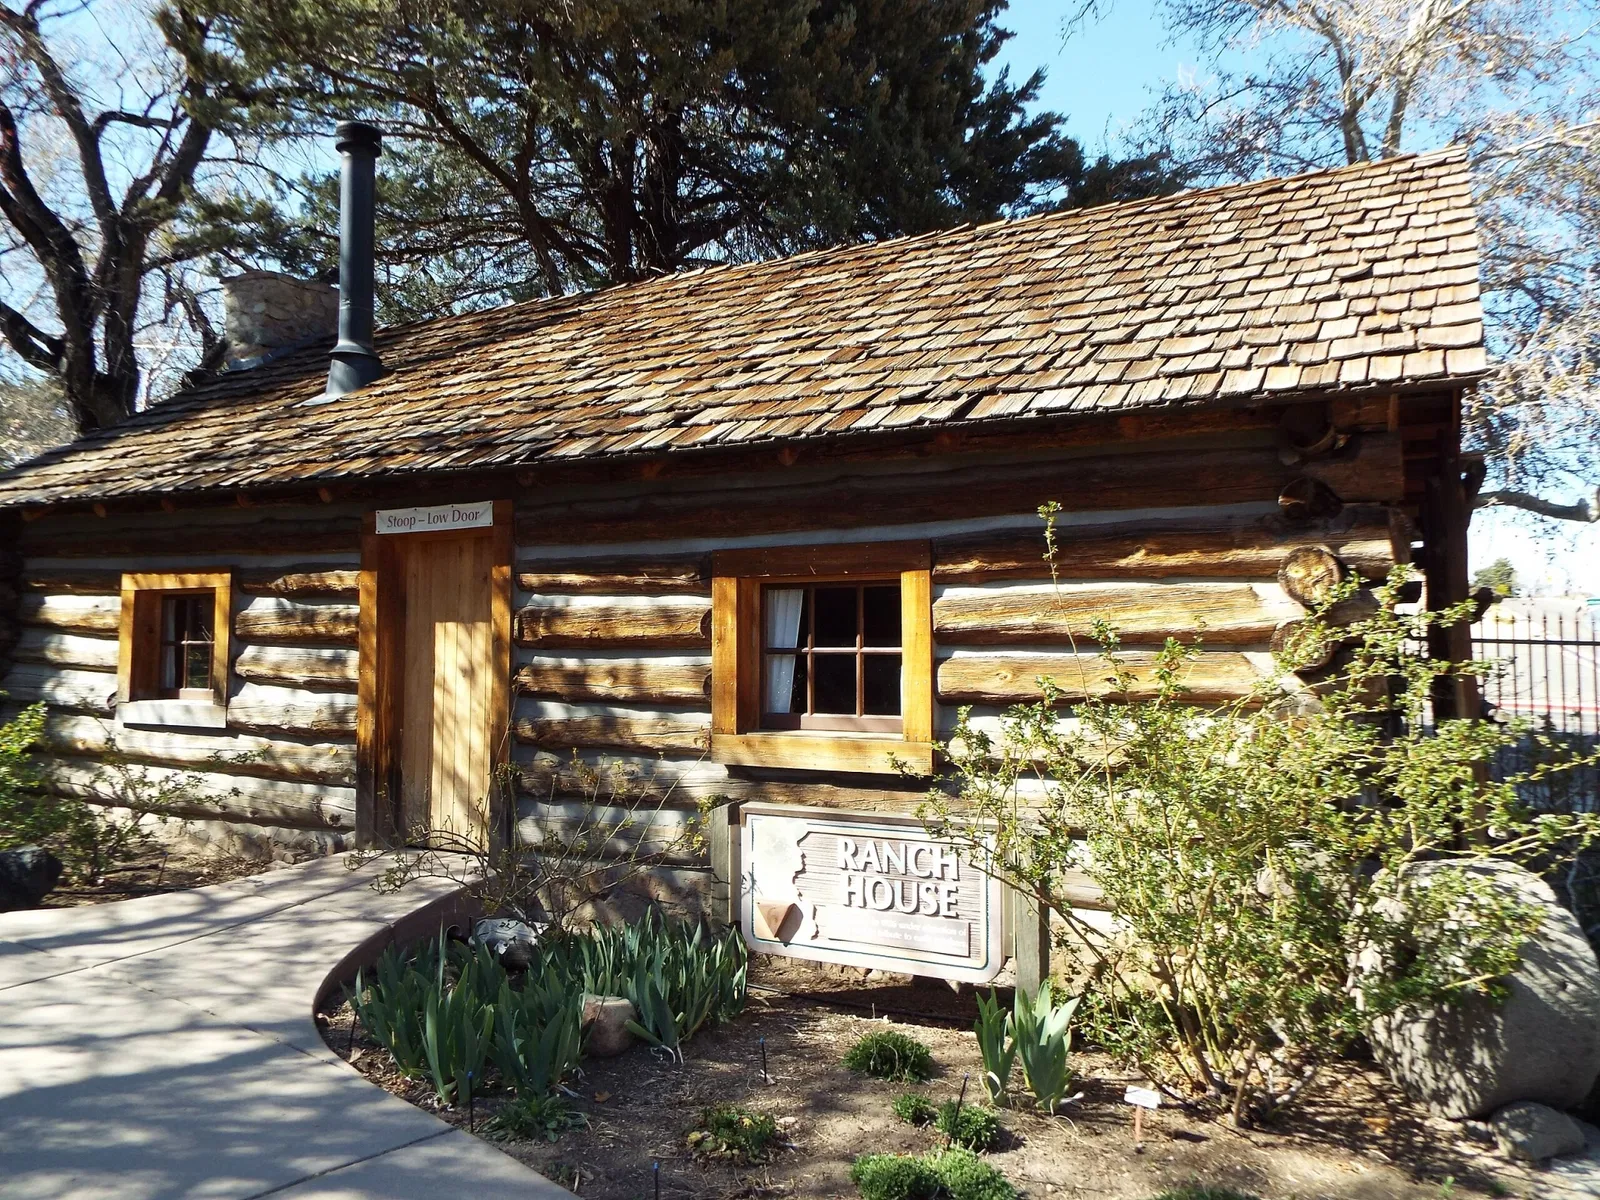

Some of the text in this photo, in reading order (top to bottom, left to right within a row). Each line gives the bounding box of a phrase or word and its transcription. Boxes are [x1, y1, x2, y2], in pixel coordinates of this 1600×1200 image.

[387, 515, 416, 530] Stoop
[427, 512, 449, 525] Low
[452, 509, 480, 522] Door
[836, 837, 960, 880] RANCH
[841, 872, 959, 918] HOUSE
